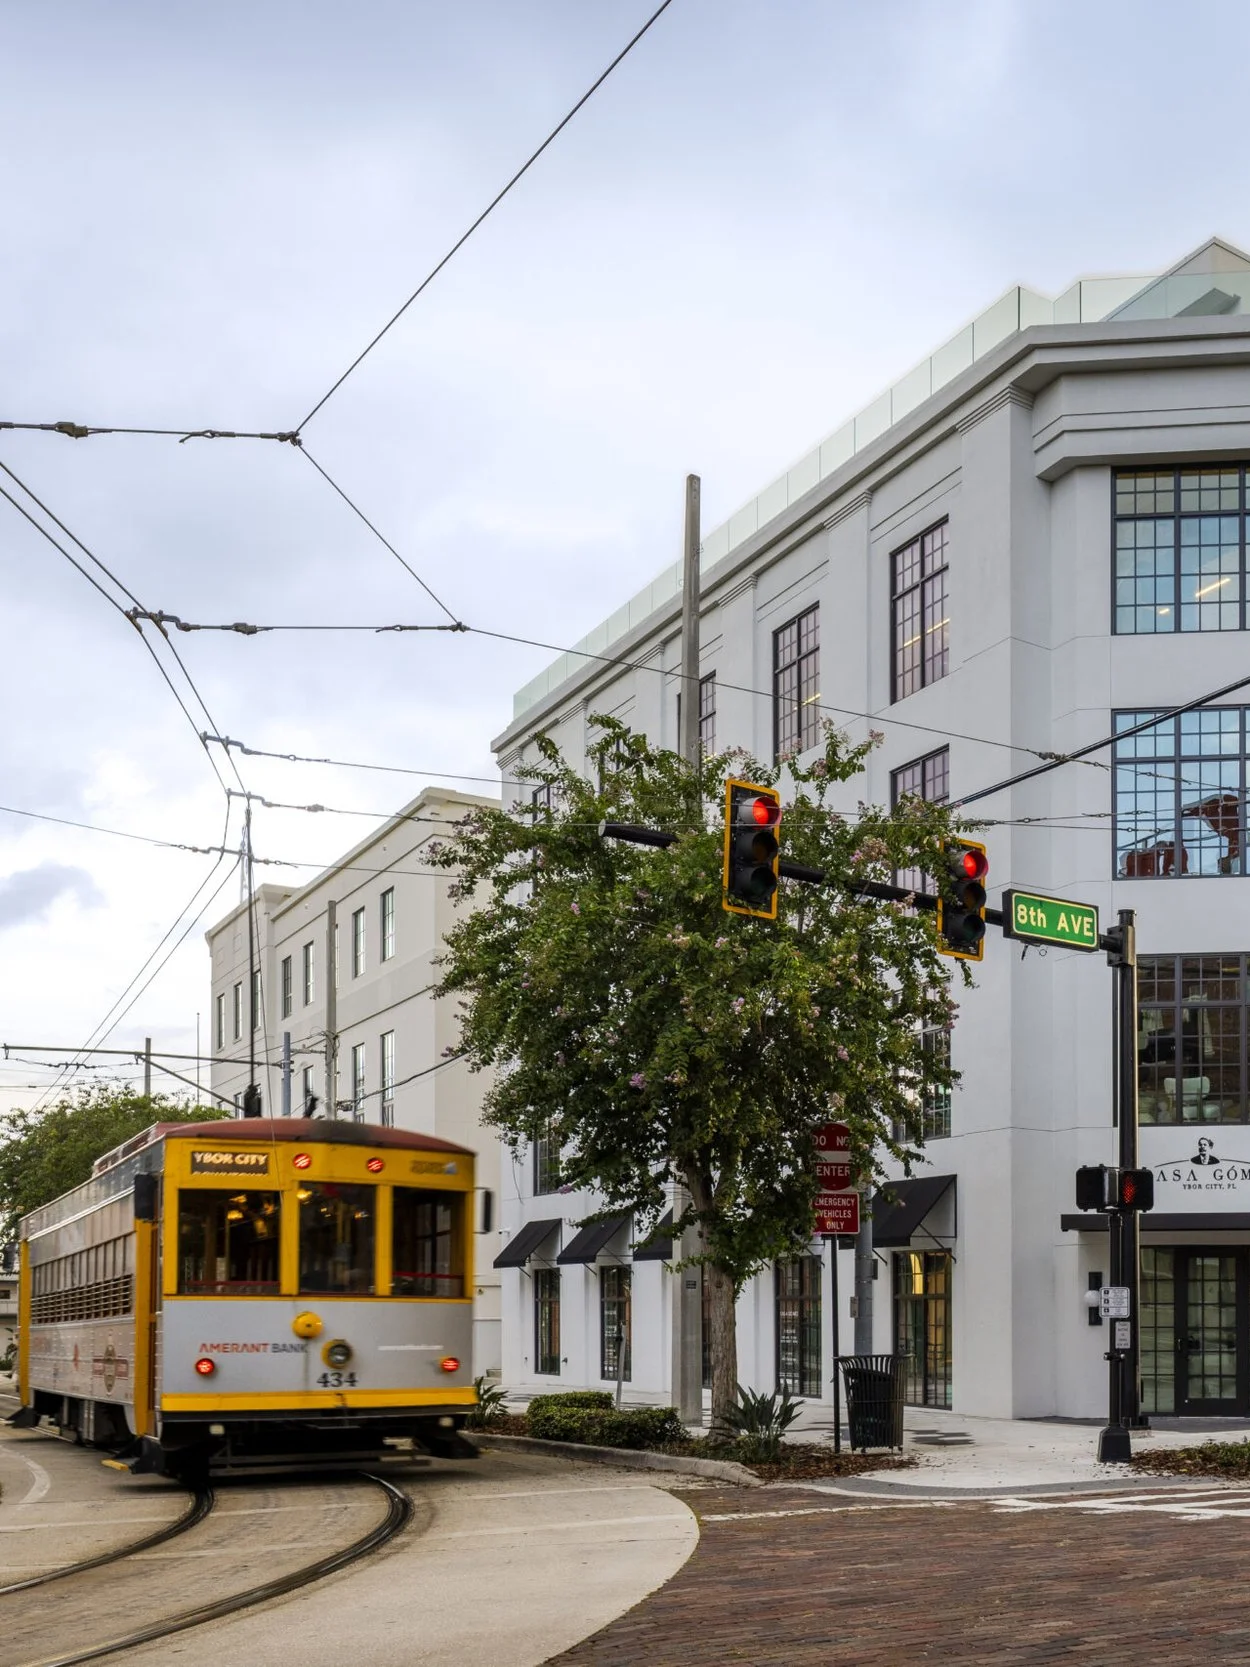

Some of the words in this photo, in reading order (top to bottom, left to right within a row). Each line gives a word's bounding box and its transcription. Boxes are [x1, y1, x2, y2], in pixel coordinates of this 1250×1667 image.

[1017, 903, 1047, 928] 8th
[1057, 912, 1094, 937] AVE
[234, 1153, 268, 1165] CITY
[816, 1165, 850, 1177] ENTER
[1156, 1169, 1198, 1182] ASA
[814, 1197, 856, 1207] EMERGENCY
[819, 1209, 852, 1219] VEHICLES
[826, 1220, 845, 1230] ONLY
[200, 1342, 269, 1353] AMERANT
[271, 1342, 308, 1353] BANK
[316, 1371, 359, 1388] 434
